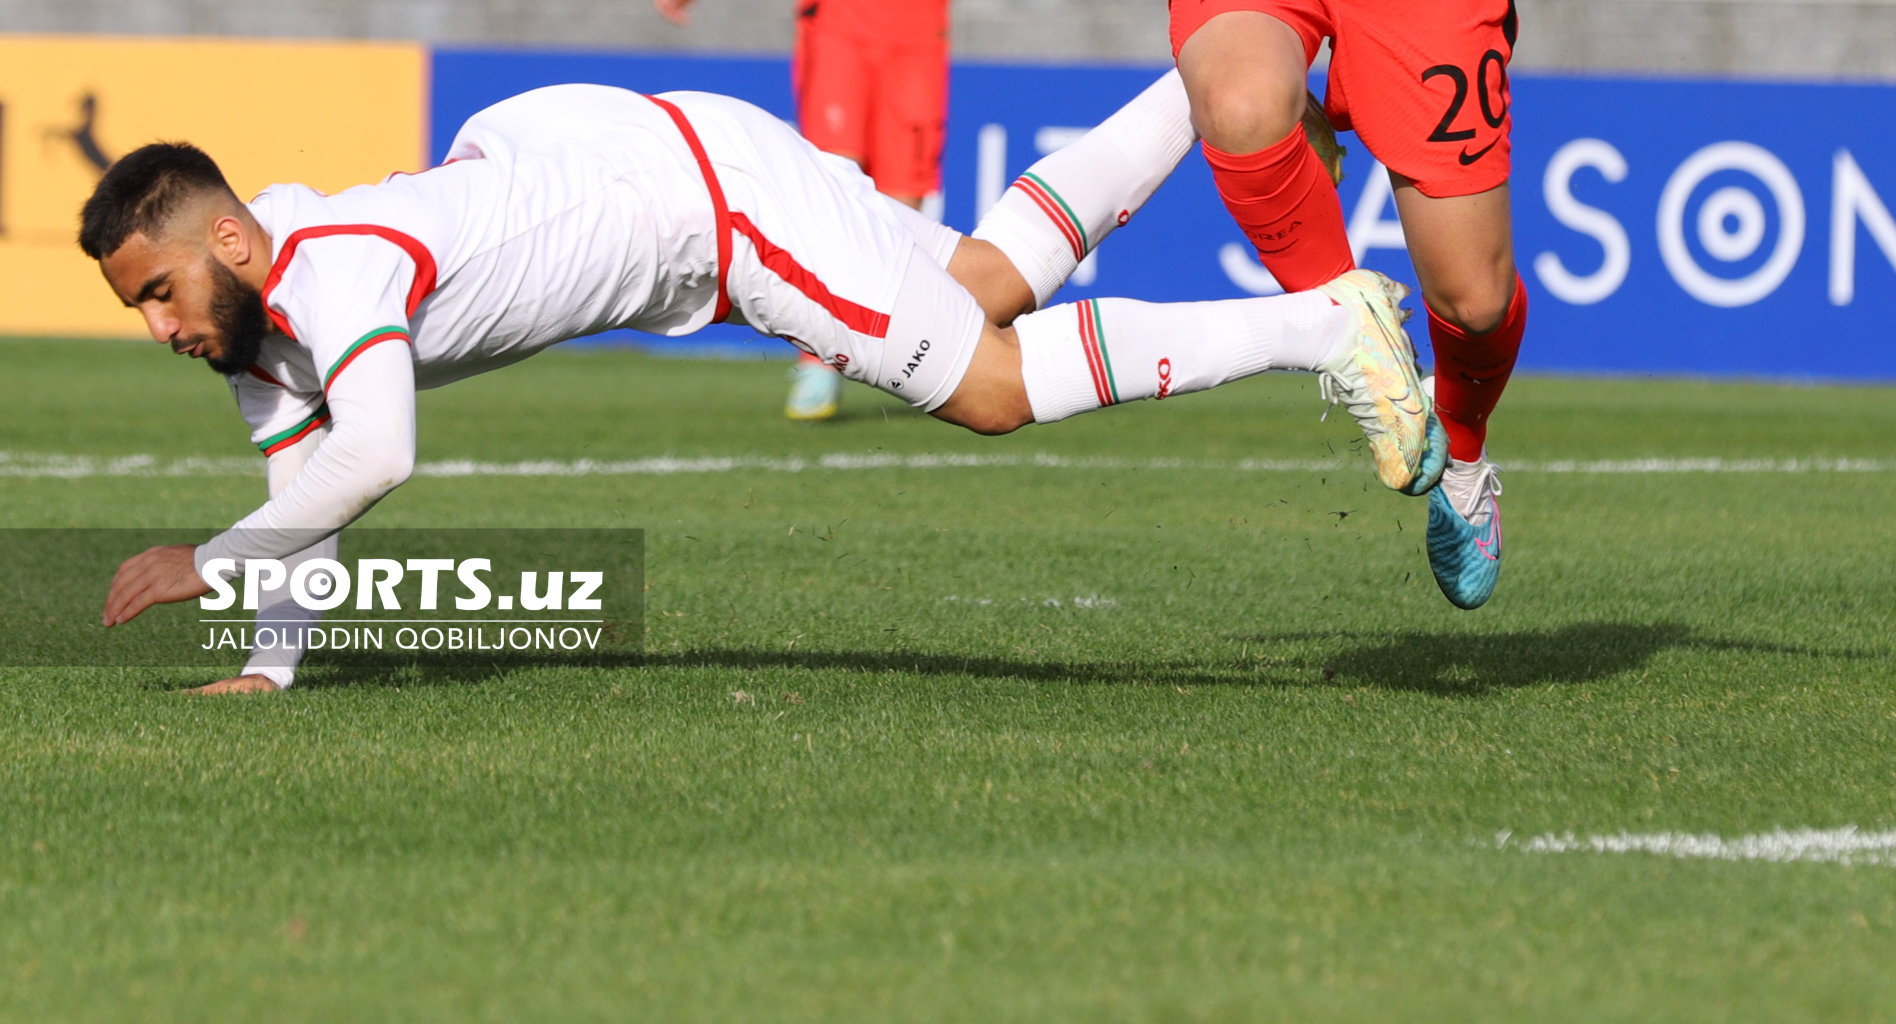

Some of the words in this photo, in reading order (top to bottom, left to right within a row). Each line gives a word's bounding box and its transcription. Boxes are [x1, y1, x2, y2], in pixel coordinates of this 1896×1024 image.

[1421, 49, 1506, 143] 20
[1243, 220, 1303, 241] OREA
[902, 339, 931, 378] JAKO
